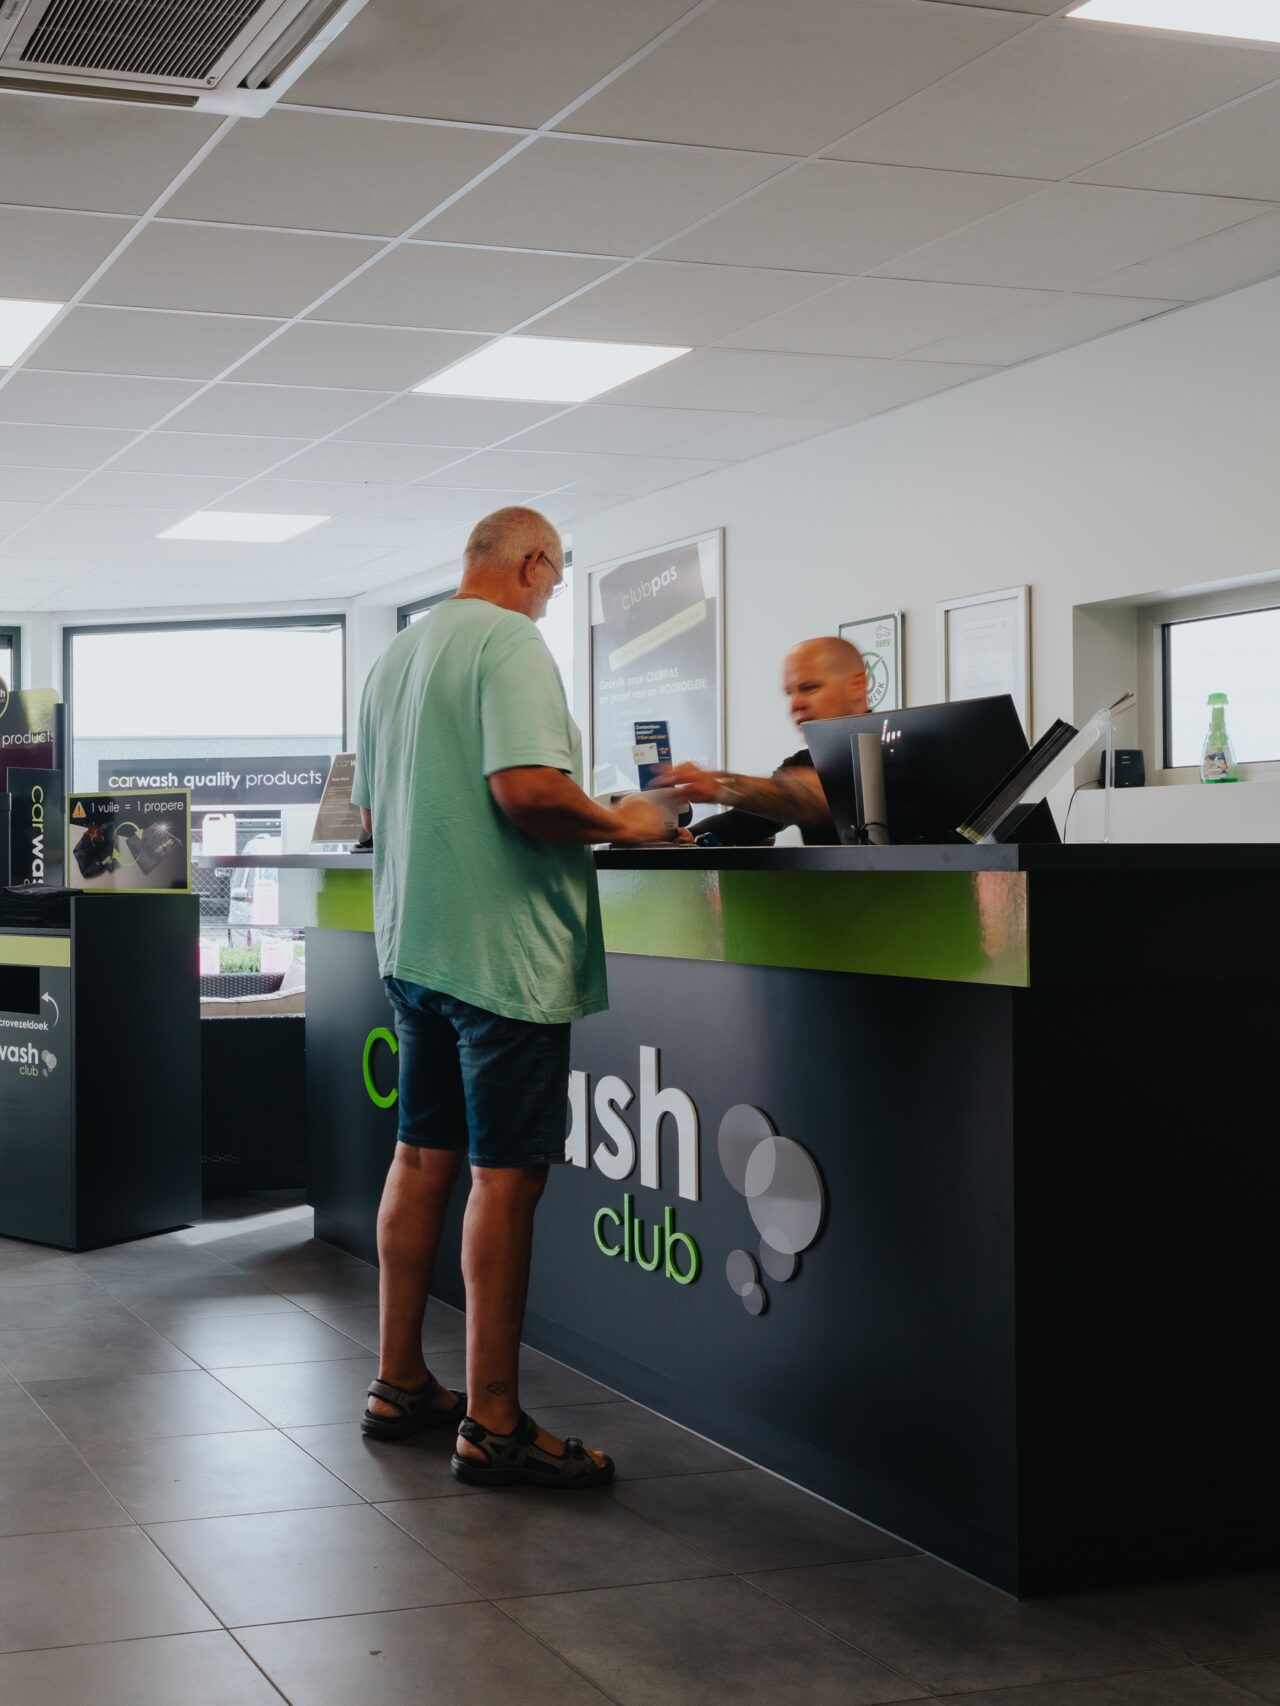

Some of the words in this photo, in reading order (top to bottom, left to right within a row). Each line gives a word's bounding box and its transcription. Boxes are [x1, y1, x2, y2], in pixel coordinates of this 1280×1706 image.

[622, 565, 678, 610] clubpas
[2, 730, 54, 749] products
[108, 772, 179, 789] carwash
[184, 772, 240, 789] quality
[246, 770, 322, 789] products
[98, 801, 120, 813] vuile
[144, 801, 184, 814] propere
[19, 1065, 39, 1077] club
[593, 1193, 700, 1285] club
